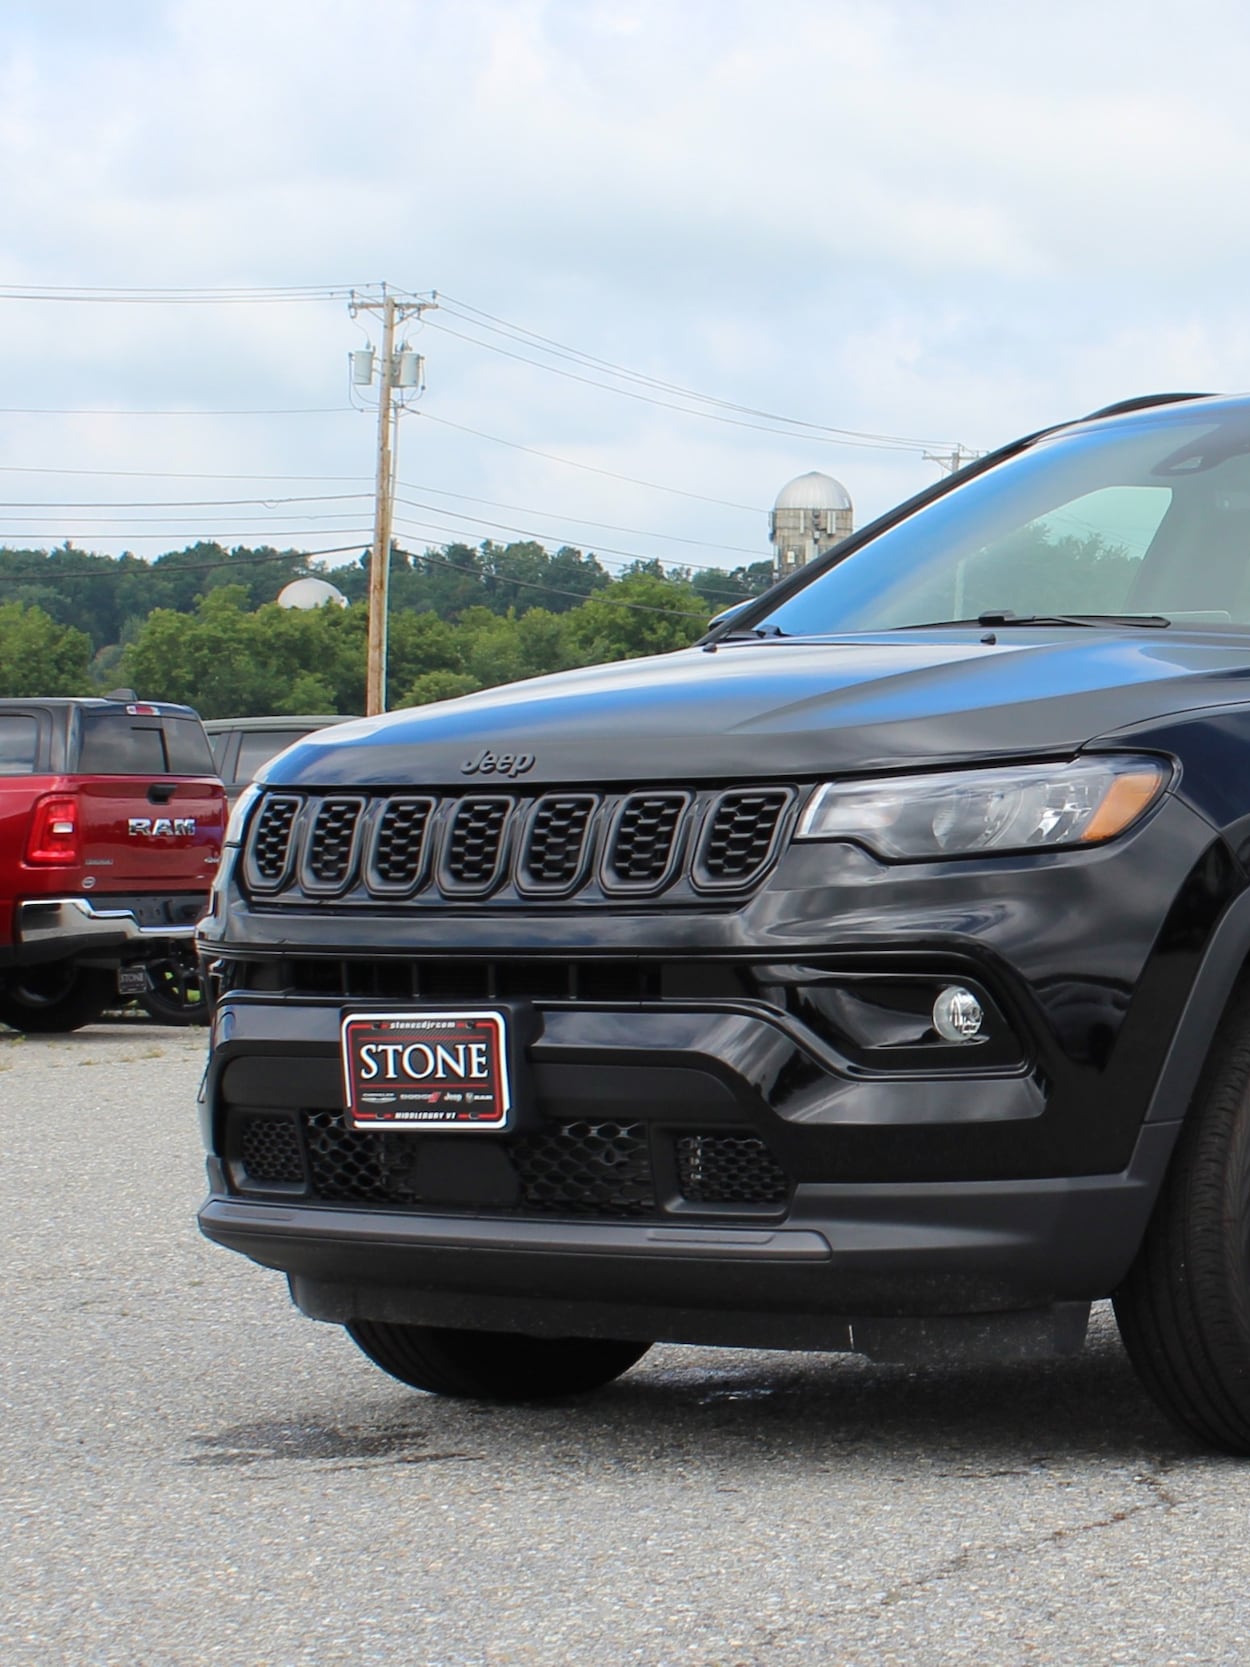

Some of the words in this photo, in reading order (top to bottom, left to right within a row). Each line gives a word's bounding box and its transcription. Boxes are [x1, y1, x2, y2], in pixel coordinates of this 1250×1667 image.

[460, 749, 536, 778] Jeep
[127, 818, 196, 836] RAM
[360, 1043, 489, 1079] STONE
[445, 1111, 457, 1120] VT
